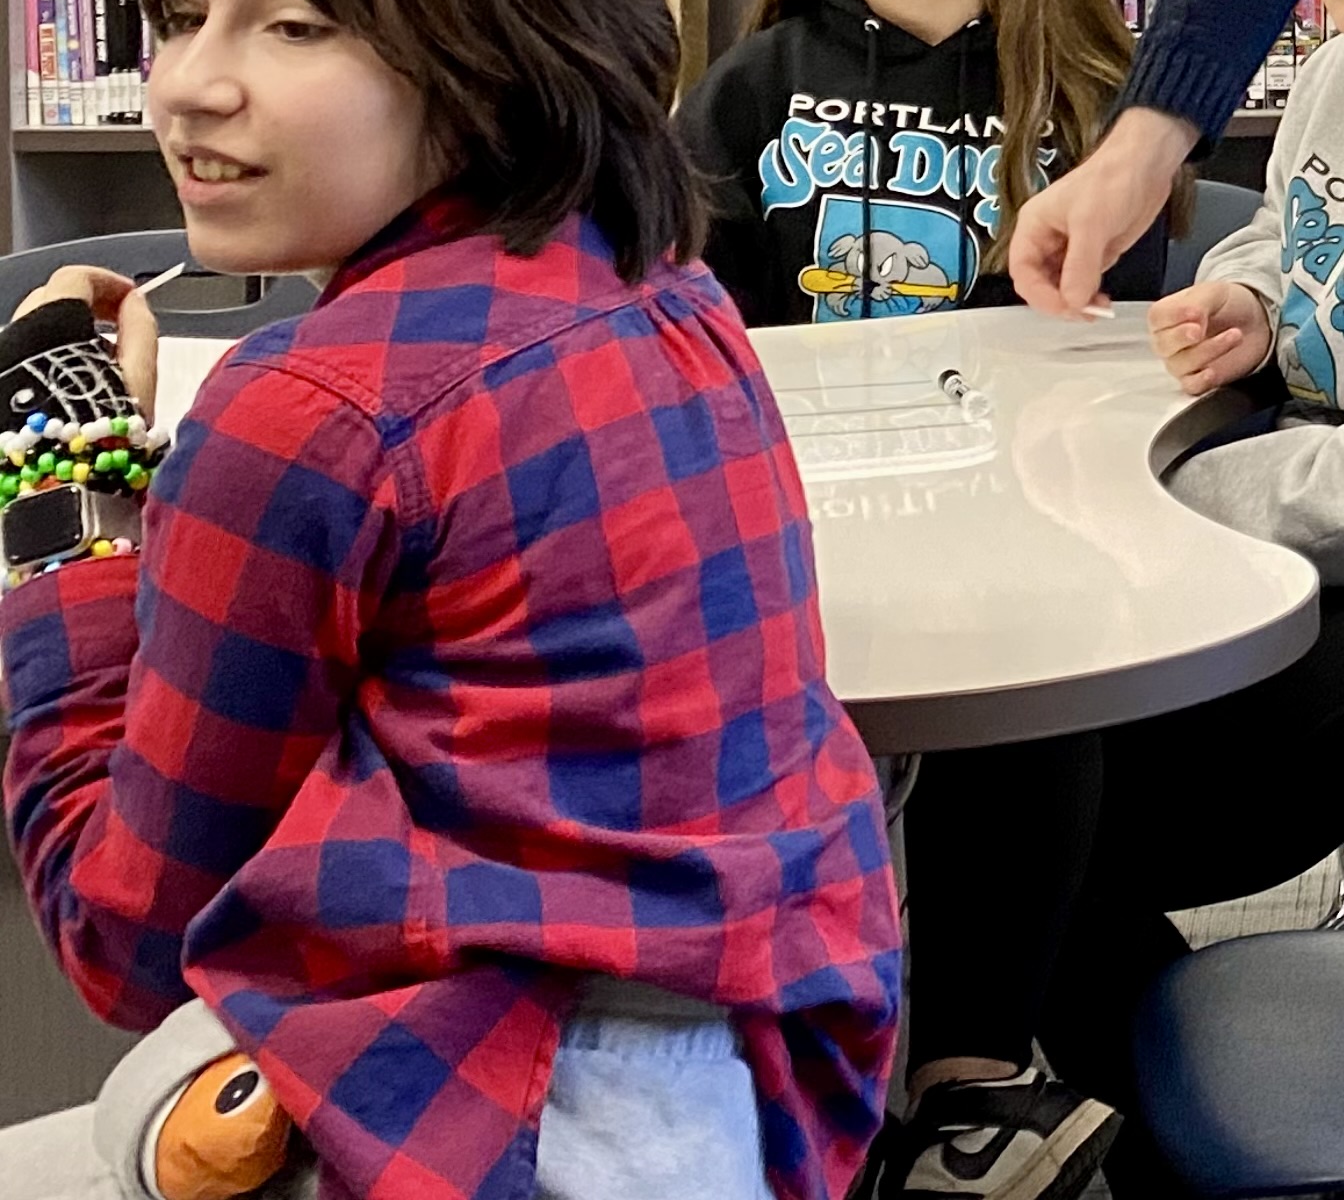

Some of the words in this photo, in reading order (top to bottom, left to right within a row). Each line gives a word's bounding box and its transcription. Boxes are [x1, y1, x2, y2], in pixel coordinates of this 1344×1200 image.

[789, 93, 1054, 138] PORTLAN
[758, 117, 880, 221] Sea
[888, 130, 1058, 241] Dog
